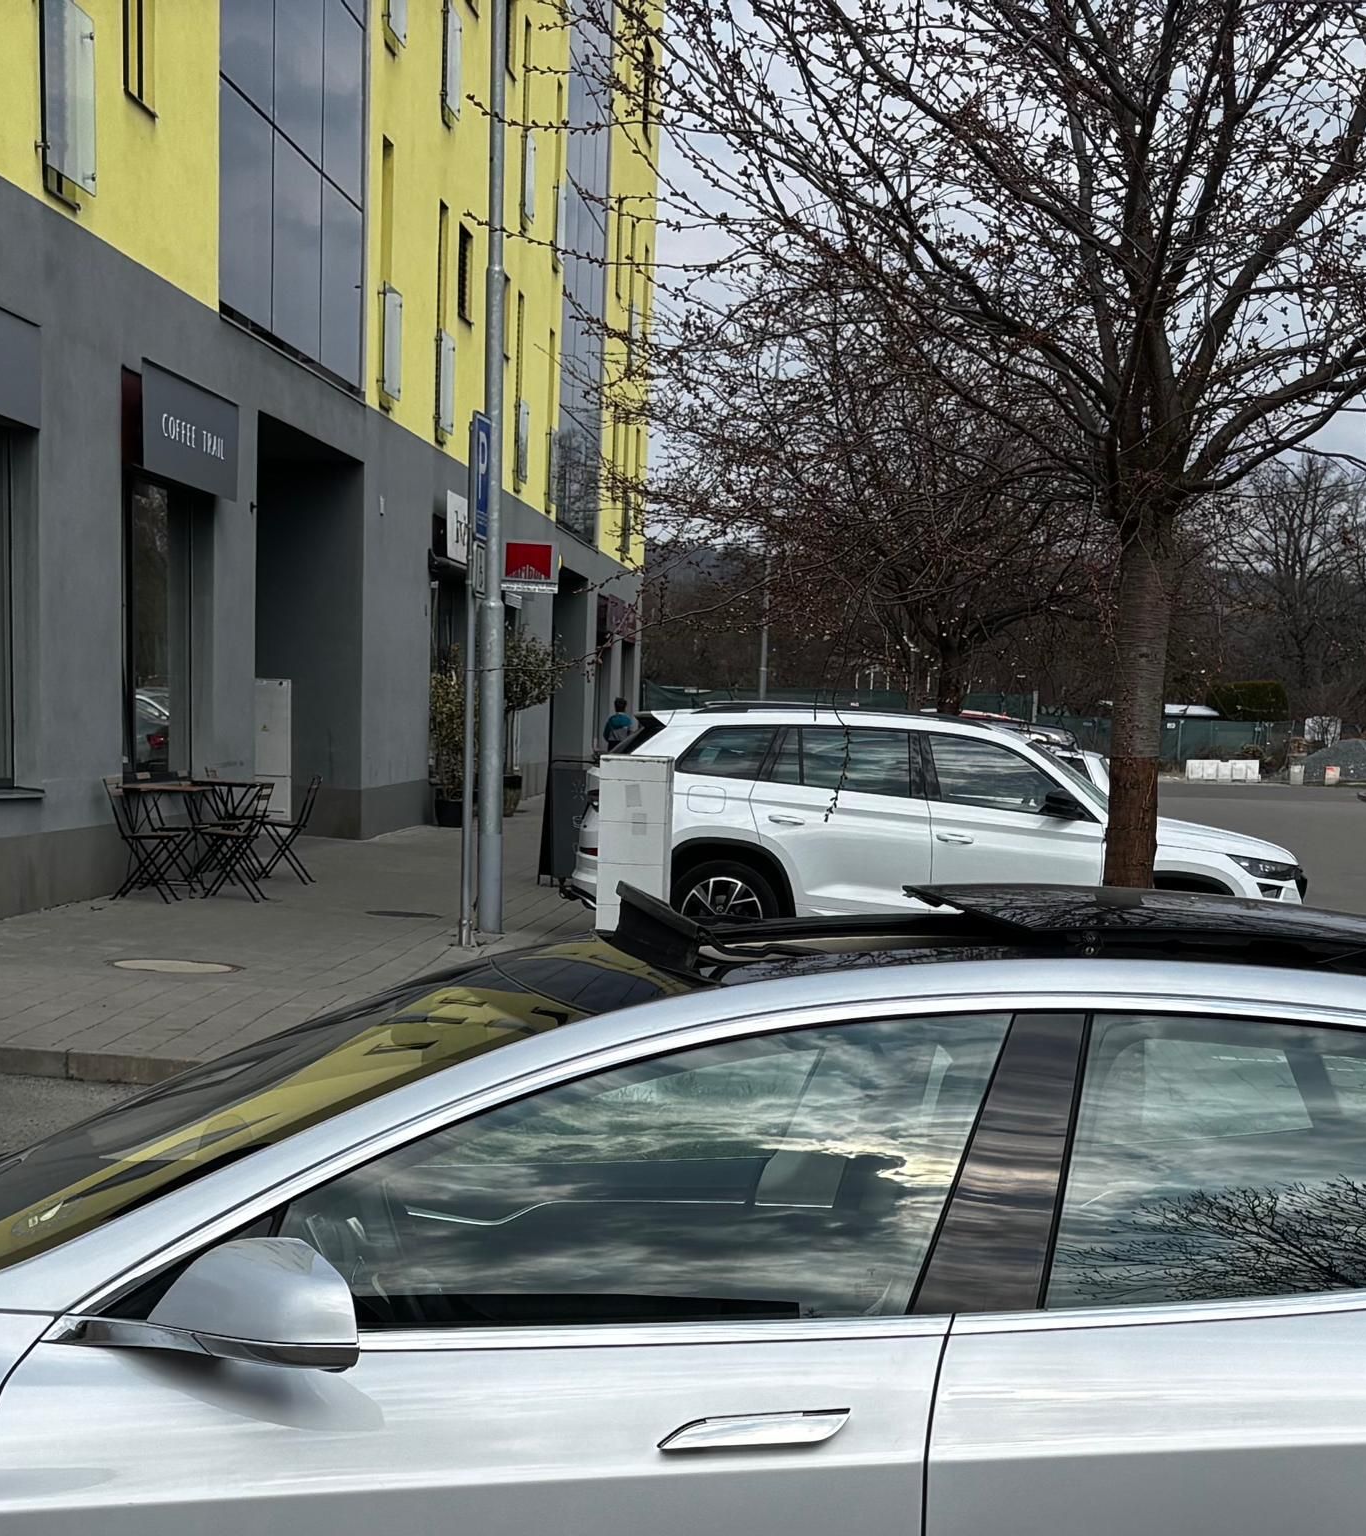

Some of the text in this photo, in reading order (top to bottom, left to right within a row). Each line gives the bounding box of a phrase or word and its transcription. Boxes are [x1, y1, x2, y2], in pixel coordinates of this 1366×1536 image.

[161, 413, 225, 461] COFFEE TRAIL
[478, 431, 488, 500] P
